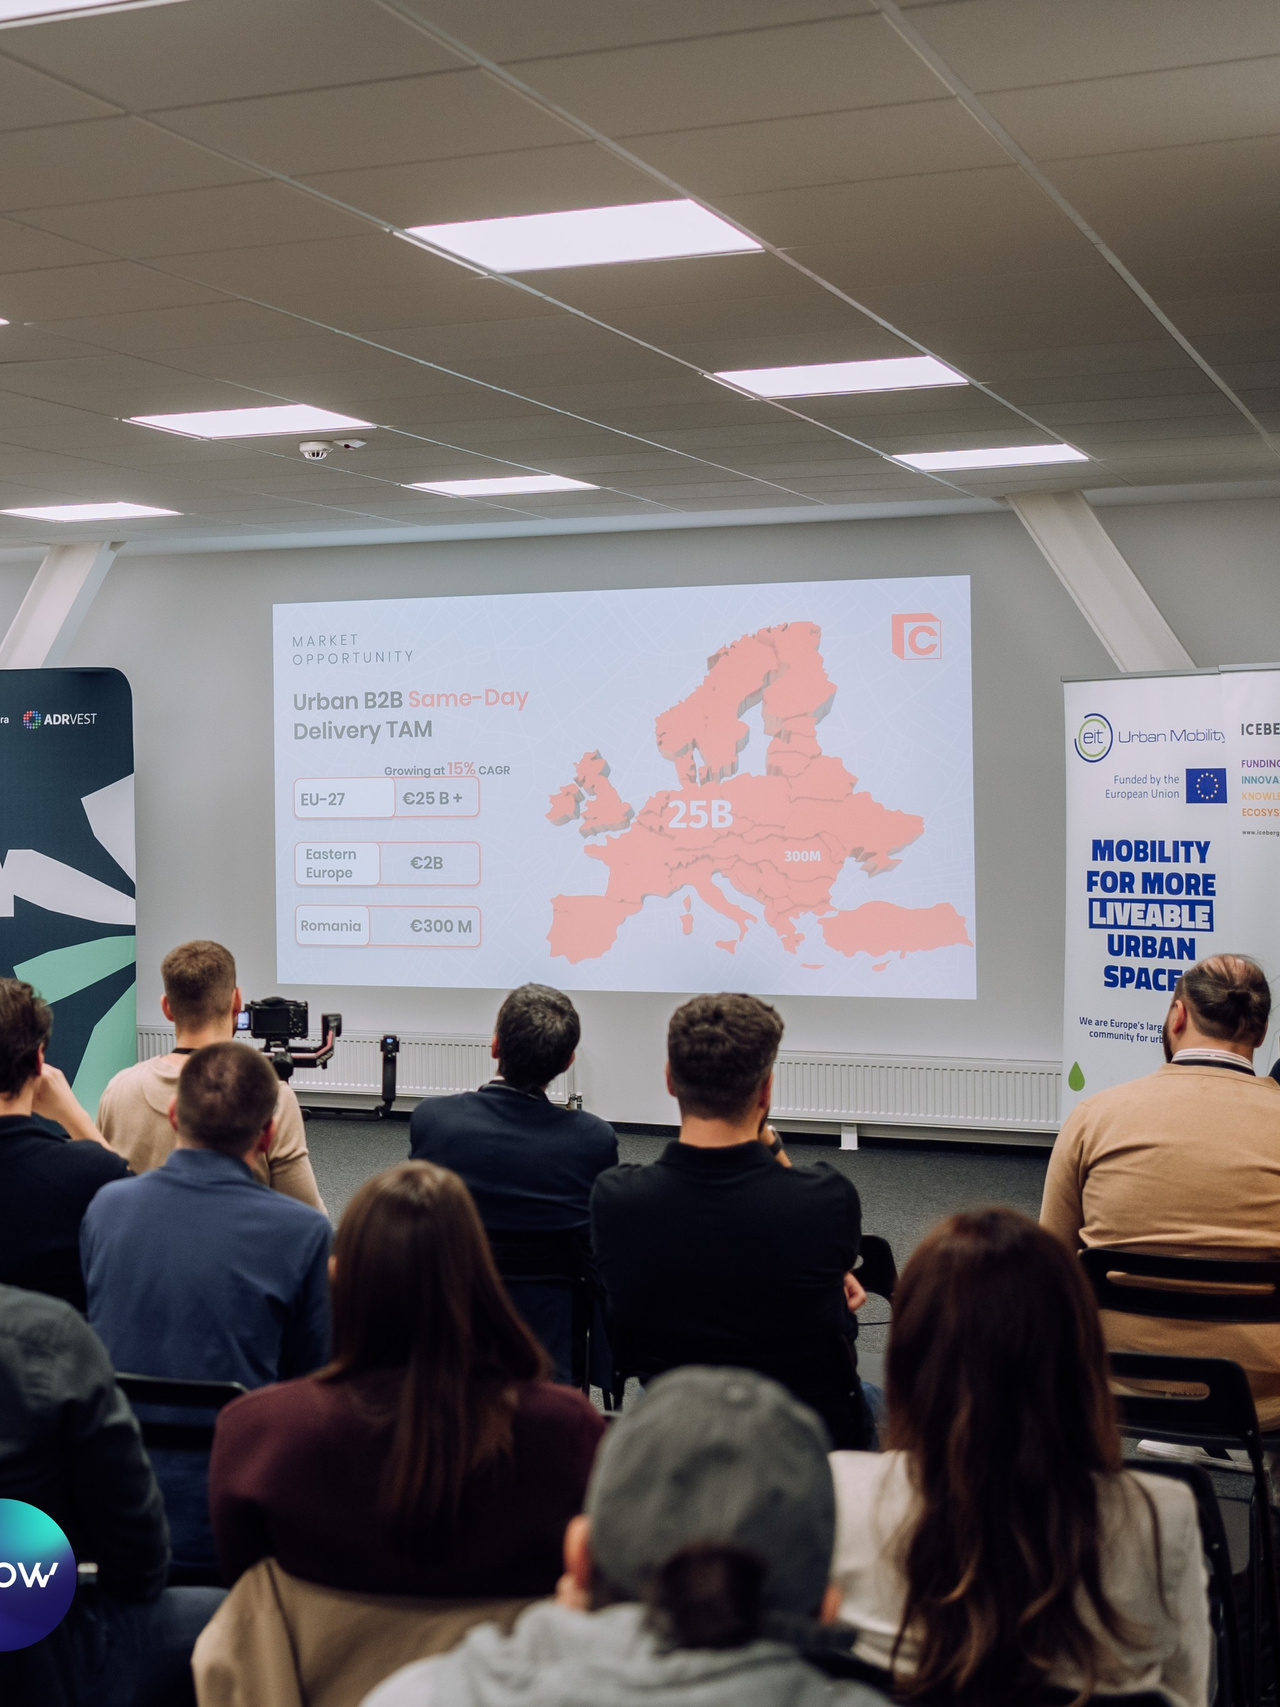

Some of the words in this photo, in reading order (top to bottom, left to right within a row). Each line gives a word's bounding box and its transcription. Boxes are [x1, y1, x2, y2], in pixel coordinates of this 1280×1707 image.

[292, 633, 358, 647] MARKET
[292, 650, 414, 666] OPPORTUNITY
[293, 692, 359, 710] Urban
[364, 691, 403, 709] B2B
[408, 688, 529, 711] Same-Day
[43, 713, 97, 725] ADRVEST
[294, 721, 381, 744] Delivery
[386, 720, 433, 738] TAM
[1083, 729, 1104, 745] eit
[1118, 730, 1166, 744] Urban
[384, 765, 431, 779] Growing
[433, 766, 445, 776] at
[447, 761, 476, 776] 15%
[478, 765, 511, 775] CAGR
[1114, 775, 1147, 785] Funded
[1150, 775, 1161, 787] by
[1164, 774, 1180, 785] the
[1241, 776, 1280, 785] INNOVA
[300, 792, 346, 806] EU-27
[402, 791, 435, 806] €25
[439, 791, 450, 805] B
[1105, 789, 1148, 801] European
[1151, 789, 1180, 799] Union
[668, 800, 734, 829] 25B
[1242, 807, 1280, 817] ECOSYS
[305, 848, 357, 860] Eastern
[784, 850, 821, 862] 300M
[1091, 839, 1211, 863] MOBILITY
[410, 856, 444, 870] €2B
[306, 866, 353, 881] Europe
[1086, 870, 1136, 894] FOR
[1141, 872, 1216, 897] MORE
[1092, 901, 1210, 930] LIVEABLE
[300, 919, 361, 932] Romania
[410, 919, 453, 933] €300
[458, 919, 472, 934] M
[1107, 933, 1196, 961] URBAN
[1103, 964, 1190, 992] SPACE
[1079, 1016, 1093, 1025] We
[1094, 1018, 1108, 1026] are
[1109, 1018, 1144, 1031] Europe's
[1146, 1021, 1163, 1034] larg
[1089, 1030, 1135, 1043] community
[1136, 1032, 1149, 1042] for
[1150, 1034, 1164, 1044] urb
